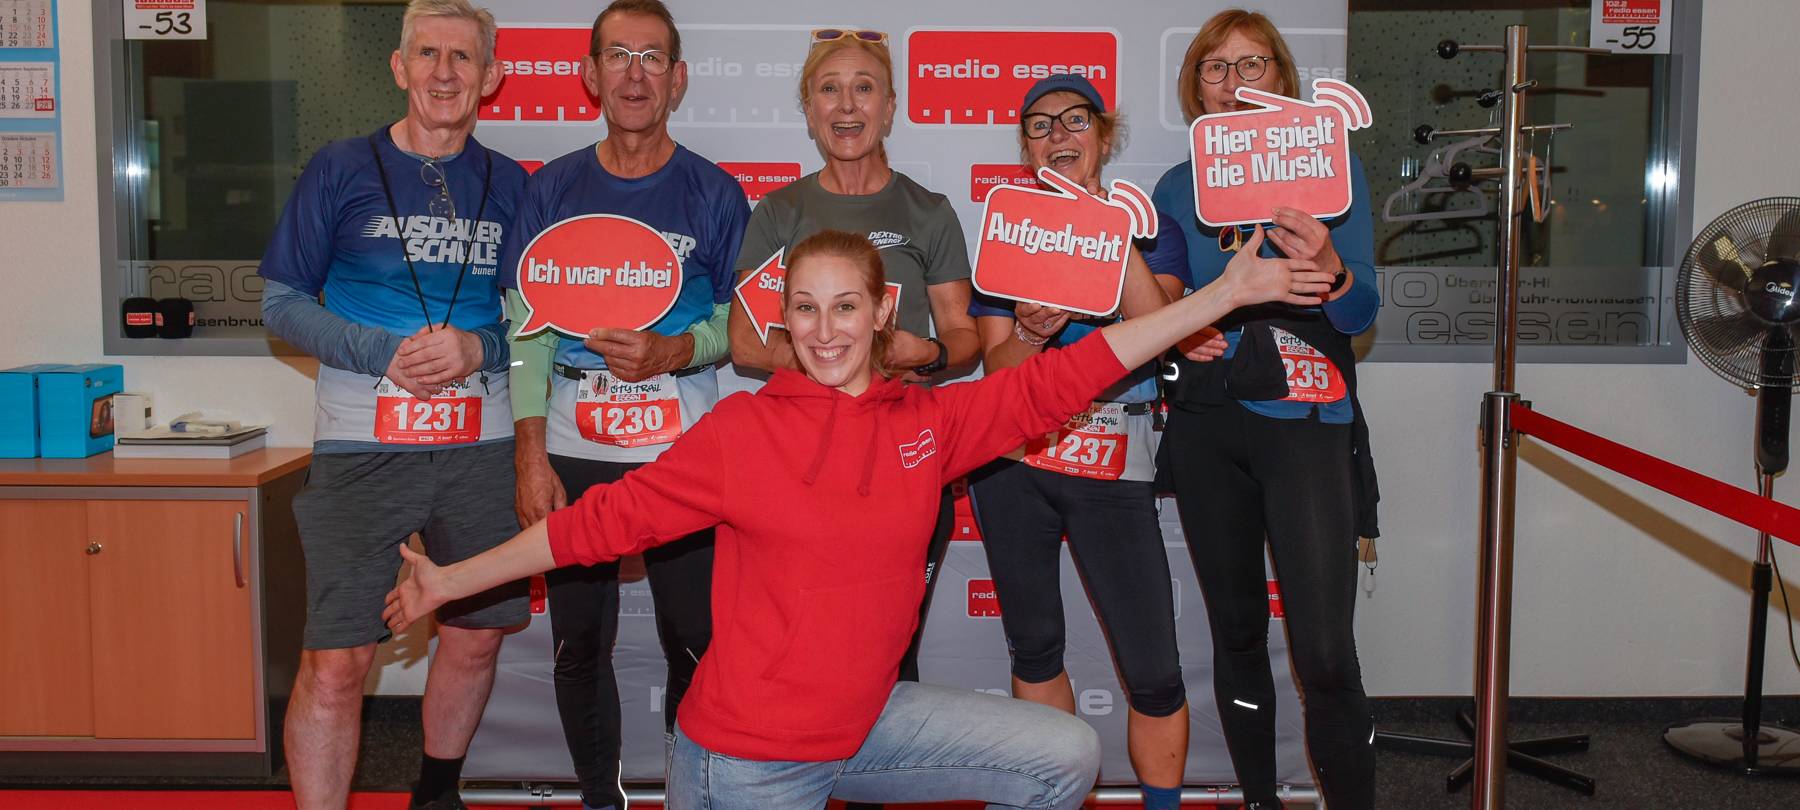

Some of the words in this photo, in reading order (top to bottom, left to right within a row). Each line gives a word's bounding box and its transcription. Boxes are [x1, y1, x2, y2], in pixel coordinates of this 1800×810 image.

[139, 11, 192, 35] -53
[1606, 26, 1656, 49] -55
[918, 59, 1000, 79] radio
[1013, 64, 1107, 80] essen
[1204, 125, 1258, 155] Hier
[1265, 115, 1335, 156] spielt
[757, 174, 797, 183] essen
[975, 176, 1009, 184] radio
[1206, 158, 1245, 188] die
[1251, 148, 1335, 183] Musik
[362, 215, 503, 244] AUSDAUER
[987, 212, 1122, 262] Aufgedreht
[404, 238, 498, 265] SCHULE
[472, 265, 497, 276] bunert
[527, 257, 560, 284] Ich
[565, 265, 611, 286] war
[615, 261, 673, 288] dabei
[393, 401, 466, 431] 1231
[590, 405, 664, 435] 1230
[1045, 429, 1117, 467] 1237
